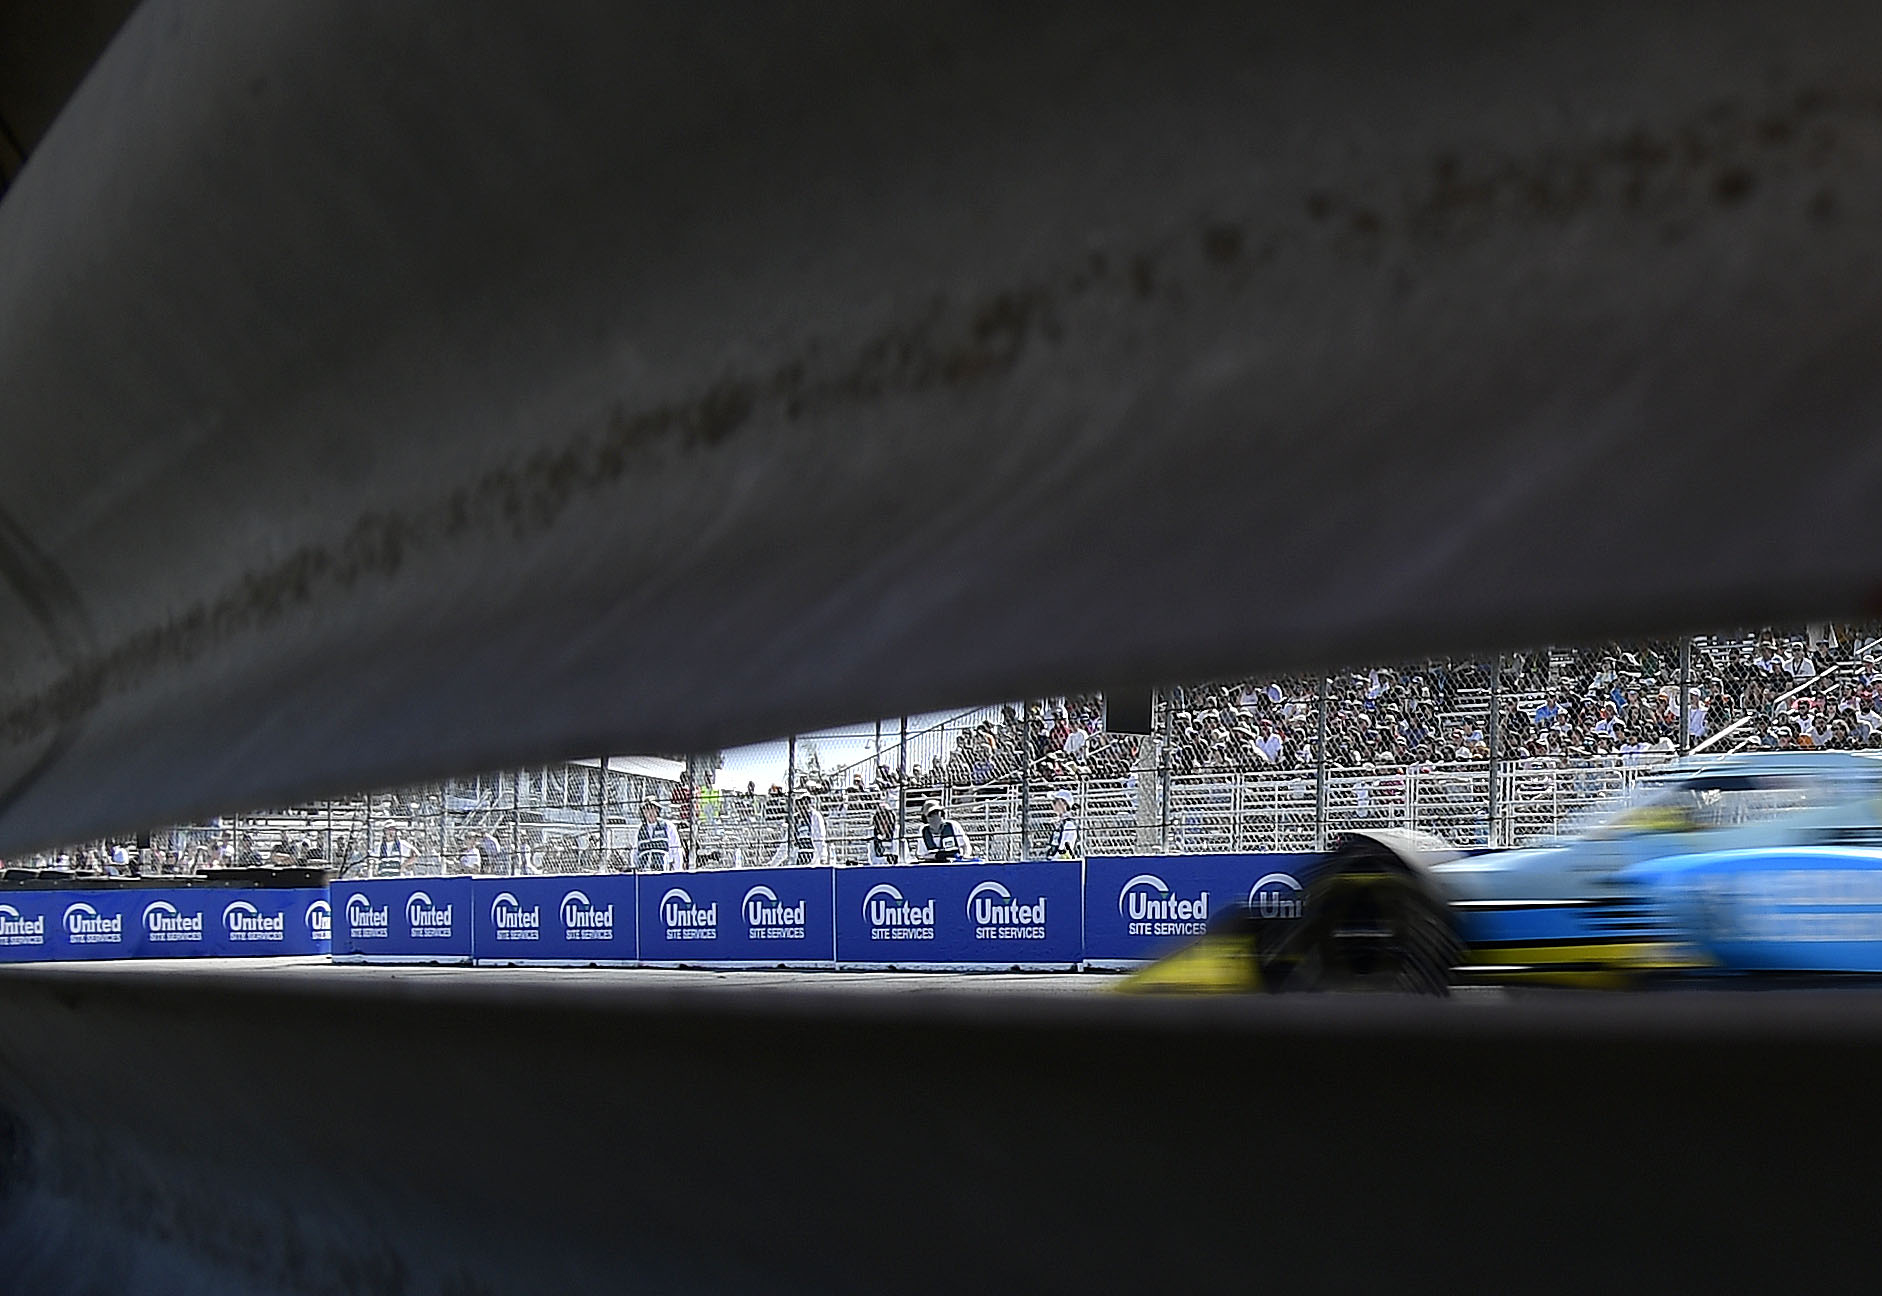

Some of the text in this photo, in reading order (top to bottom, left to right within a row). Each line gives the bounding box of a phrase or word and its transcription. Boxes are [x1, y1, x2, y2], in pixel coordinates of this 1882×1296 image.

[666, 902, 717, 926] United
[749, 900, 805, 925] United
[871, 900, 934, 925] United
[975, 898, 1045, 924] United
[1129, 892, 1207, 920] United
[1260, 891, 1303, 918] Uni
[70, 914, 122, 933] United
[150, 912, 202, 931] United
[230, 912, 284, 931] United
[350, 906, 388, 926] United
[411, 904, 452, 926] United
[496, 906, 539, 928] United
[566, 904, 613, 927] United
[566, 929, 613, 940] SITE SERVICES
[666, 928, 717, 940] SITE SERVICES
[749, 927, 804, 939] SITE SERVICES
[871, 928, 934, 939] SITE SERVICES
[976, 926, 1045, 939] SITE SERVICES
[1129, 923, 1207, 935] SITE SERVICES
